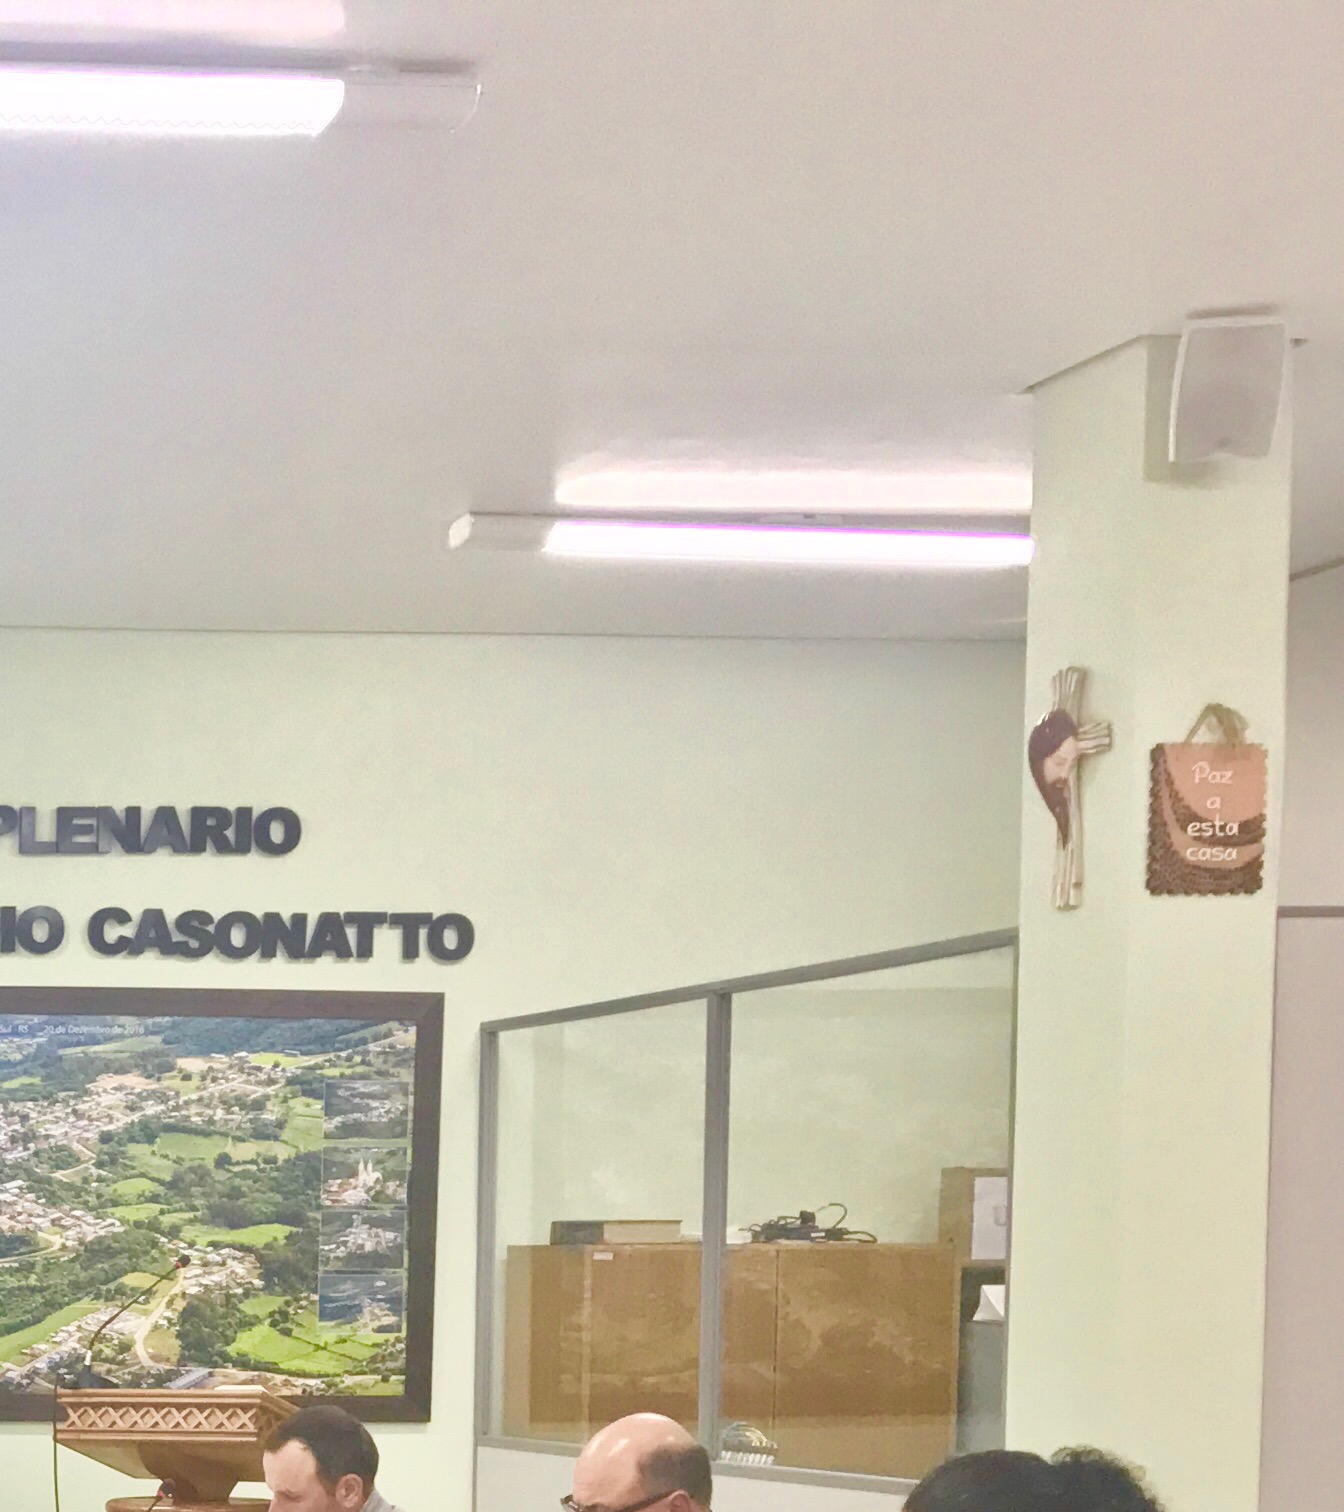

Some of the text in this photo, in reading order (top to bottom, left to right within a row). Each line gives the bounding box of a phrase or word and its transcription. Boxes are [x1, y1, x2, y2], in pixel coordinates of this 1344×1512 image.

[1191, 761, 1234, 785] Paz
[1206, 796, 1221, 810] a
[1186, 812, 1240, 837] esta
[1185, 845, 1238, 862] casa
[86, 908, 476, 964] CASONATTO
